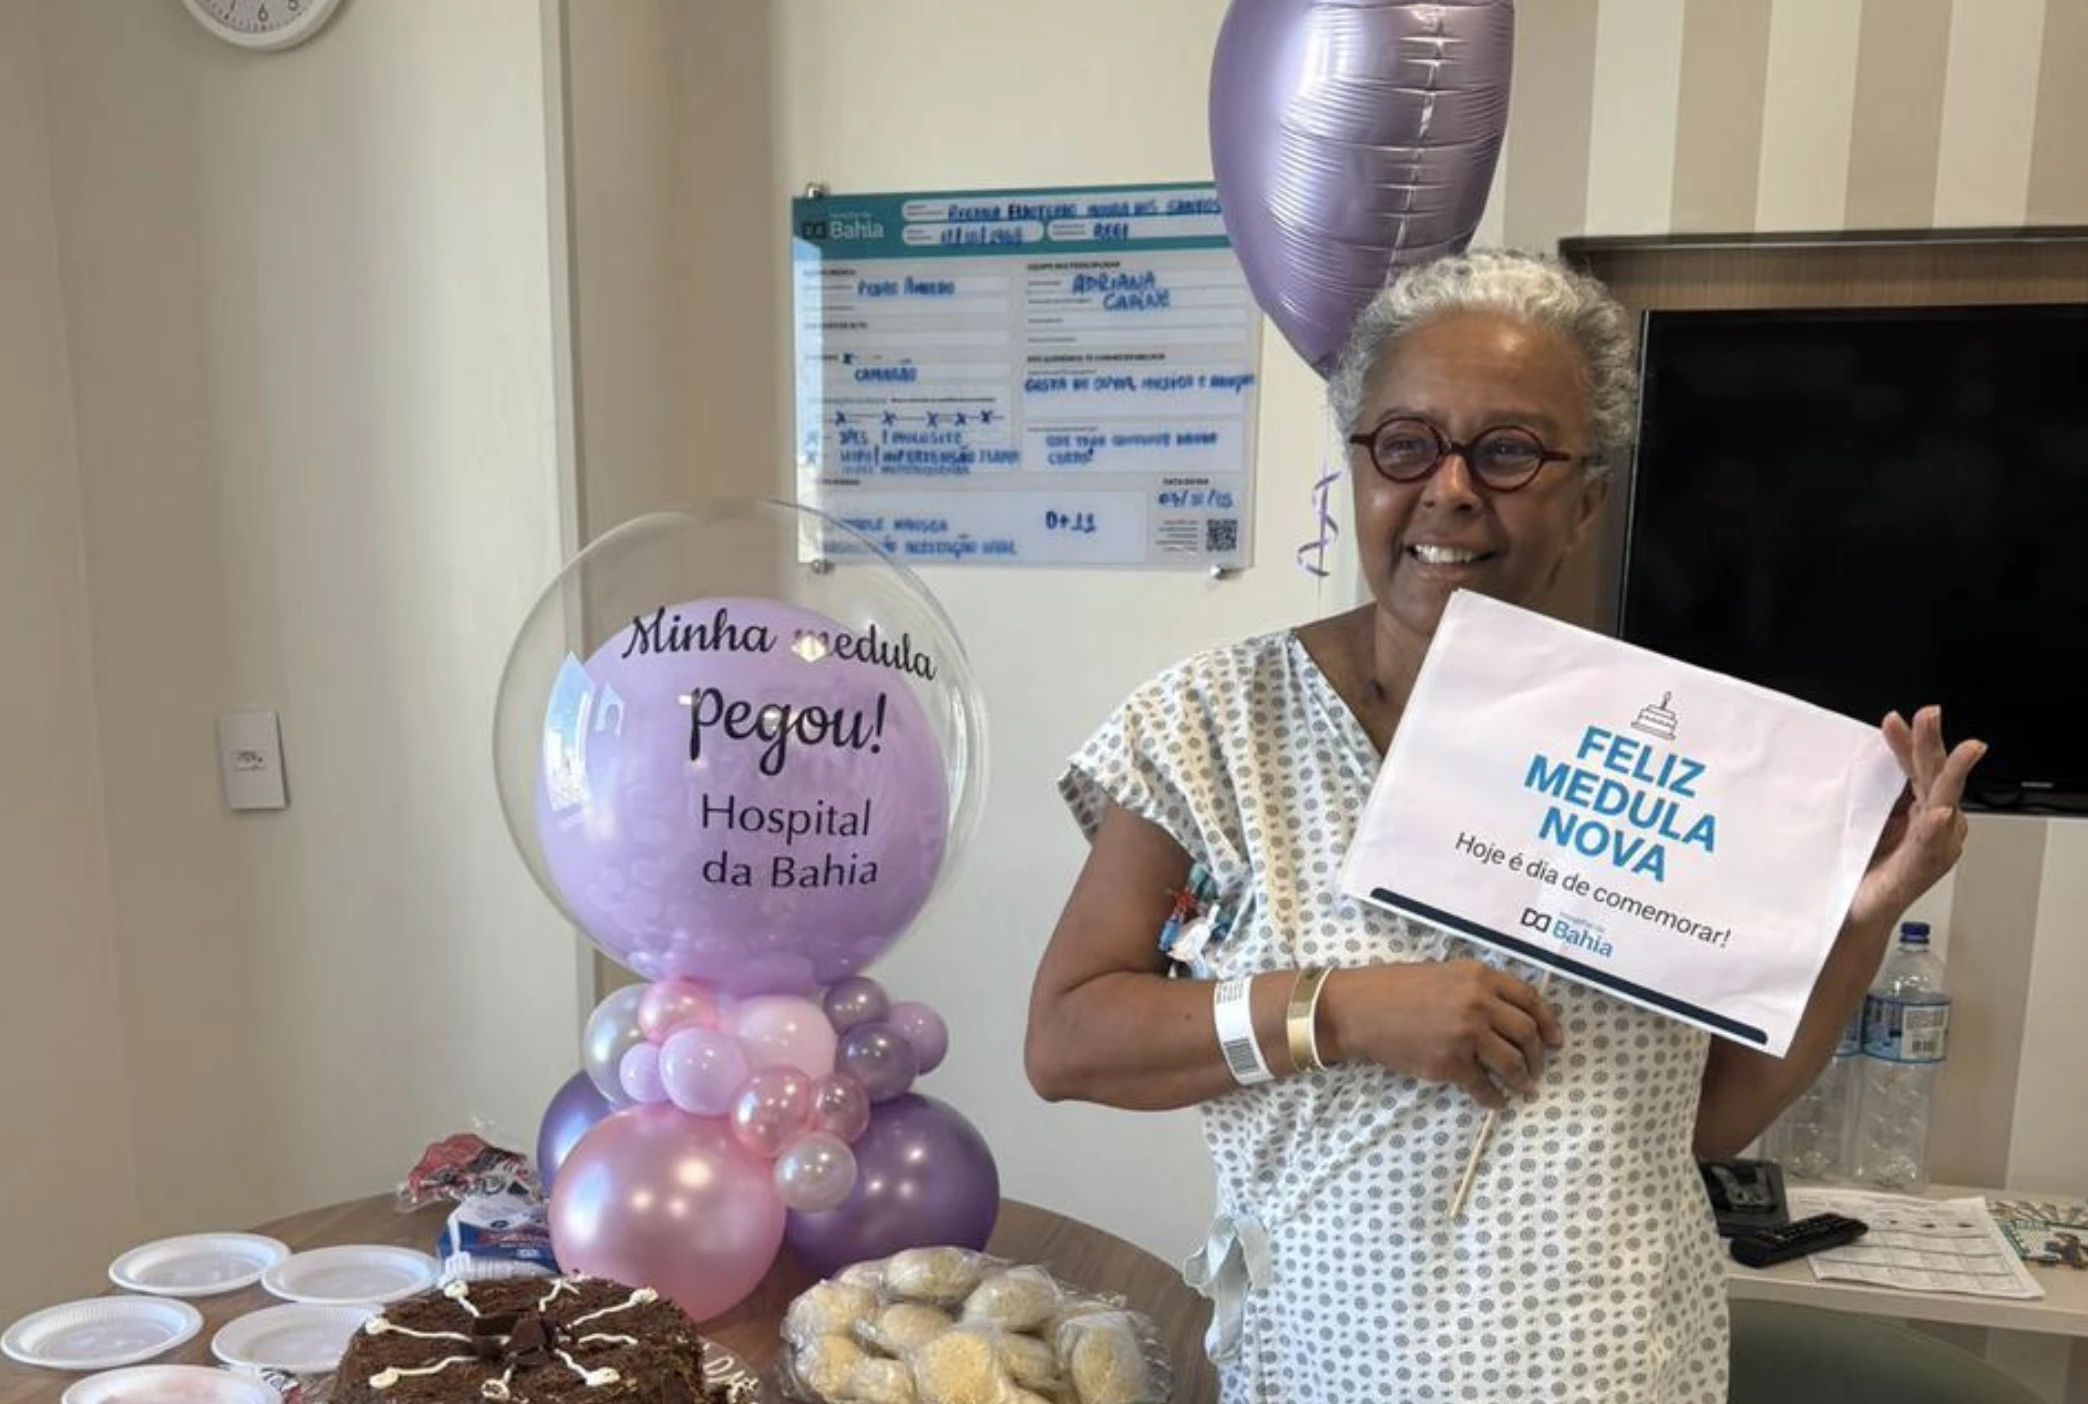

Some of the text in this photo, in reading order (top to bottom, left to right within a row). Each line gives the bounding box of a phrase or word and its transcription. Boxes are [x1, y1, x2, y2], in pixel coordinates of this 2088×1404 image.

[830, 220, 884, 239] Bahia
[1072, 270, 1156, 295] ADRIANA
[622, 606, 778, 659] Minha
[1577, 725, 1706, 798] FELIZ
[701, 793, 872, 846] Hospital
[1524, 754, 1717, 853] MEDULA
[702, 850, 878, 889] da Bahia
[1538, 806, 1667, 883] NOVA
[1455, 832, 1506, 866] Hoje
[1508, 852, 1524, 873] é
[1526, 859, 1559, 885] dia
[1562, 872, 1591, 897] de
[1593, 887, 1733, 949] comemorar!
[1552, 919, 1614, 959] Bahia
